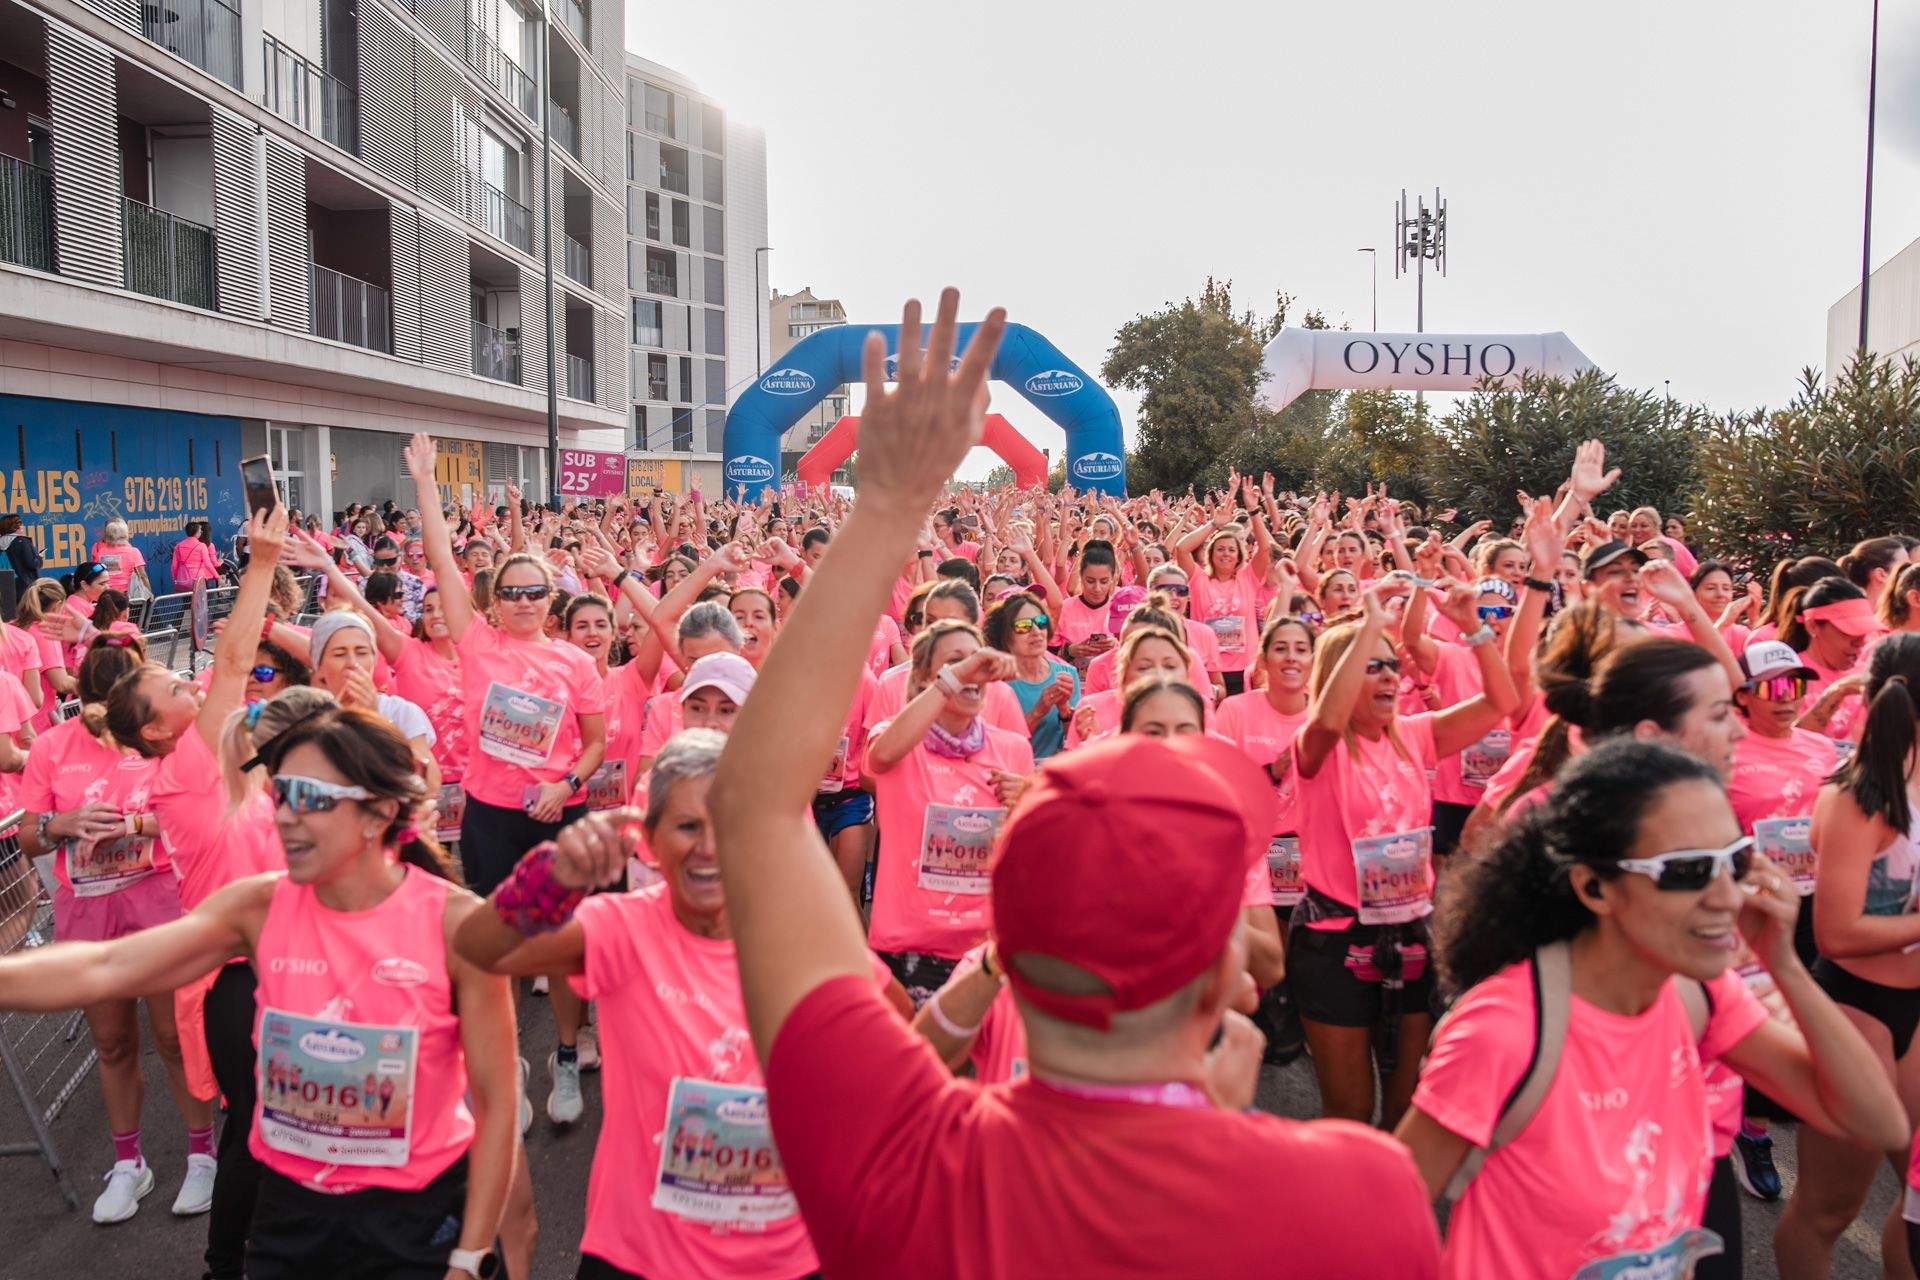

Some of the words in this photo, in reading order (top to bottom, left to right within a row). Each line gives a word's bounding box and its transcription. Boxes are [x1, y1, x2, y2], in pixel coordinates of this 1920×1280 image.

[1343, 340, 1517, 378] OYSHO
[763, 378, 812, 390] ASTURIANA
[1030, 380, 1080, 392] ASTURIANA
[564, 452, 597, 468] SUB
[602, 468, 625, 477] OYSHO
[728, 465, 772, 477] ASTURIANA
[1076, 463, 1121, 474] ASTURIANA
[630, 475, 656, 487] LOCAL
[124, 476, 156, 513] 976
[157, 477, 183, 512] 219
[184, 476, 208, 511] 115
[503, 719, 531, 737] 016
[954, 845, 988, 860] 016
[269, 957, 328, 977] OSHO
[301, 1081, 358, 1108] 016
[716, 1146, 772, 1169] 016
